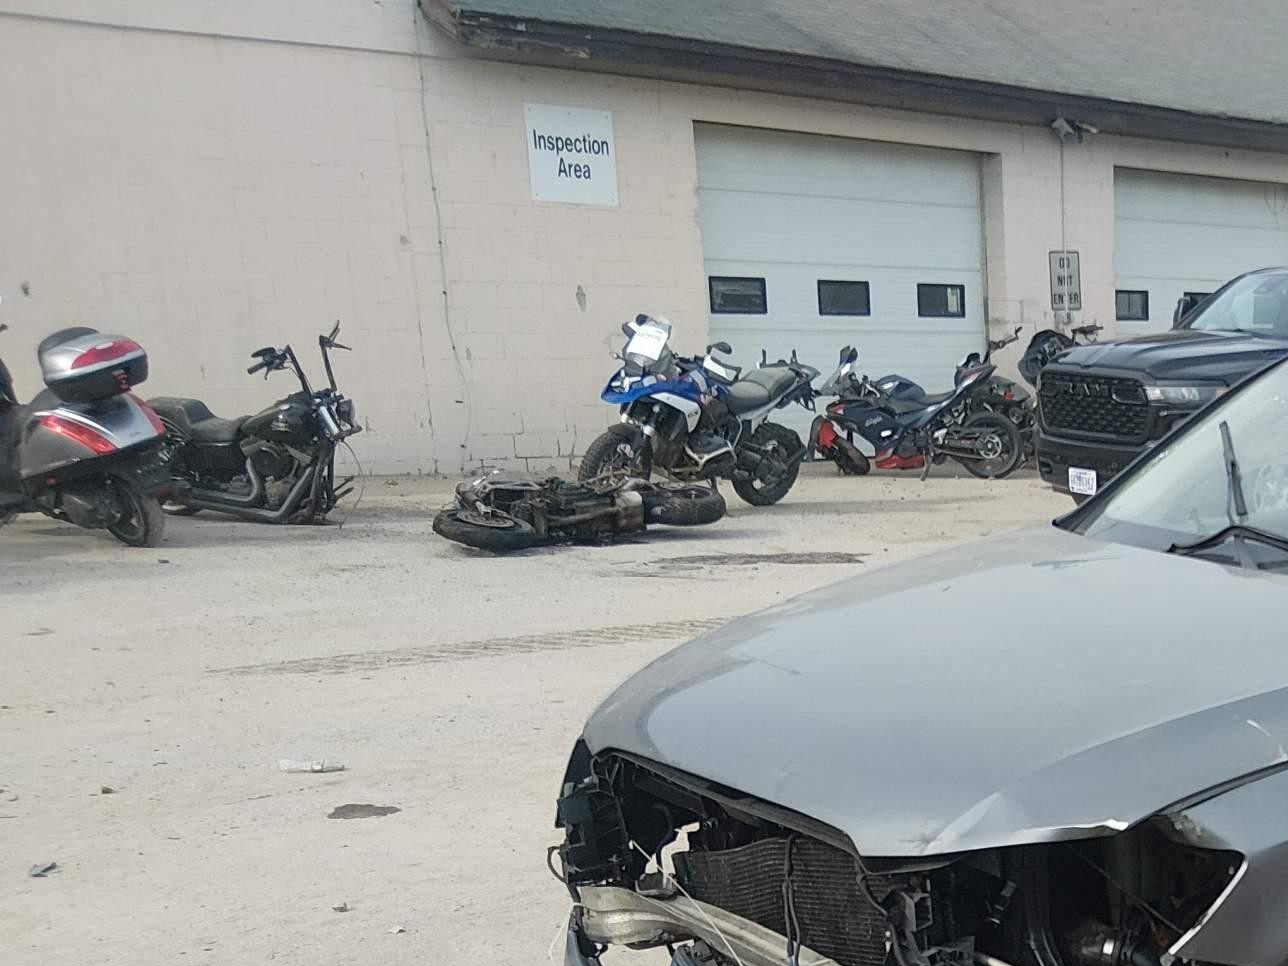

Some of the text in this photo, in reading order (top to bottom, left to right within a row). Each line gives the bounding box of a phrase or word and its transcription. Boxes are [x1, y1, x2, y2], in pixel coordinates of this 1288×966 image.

[532, 128, 610, 156] Inspection
[557, 157, 592, 180] Area
[1053, 293, 1080, 305] ENER
